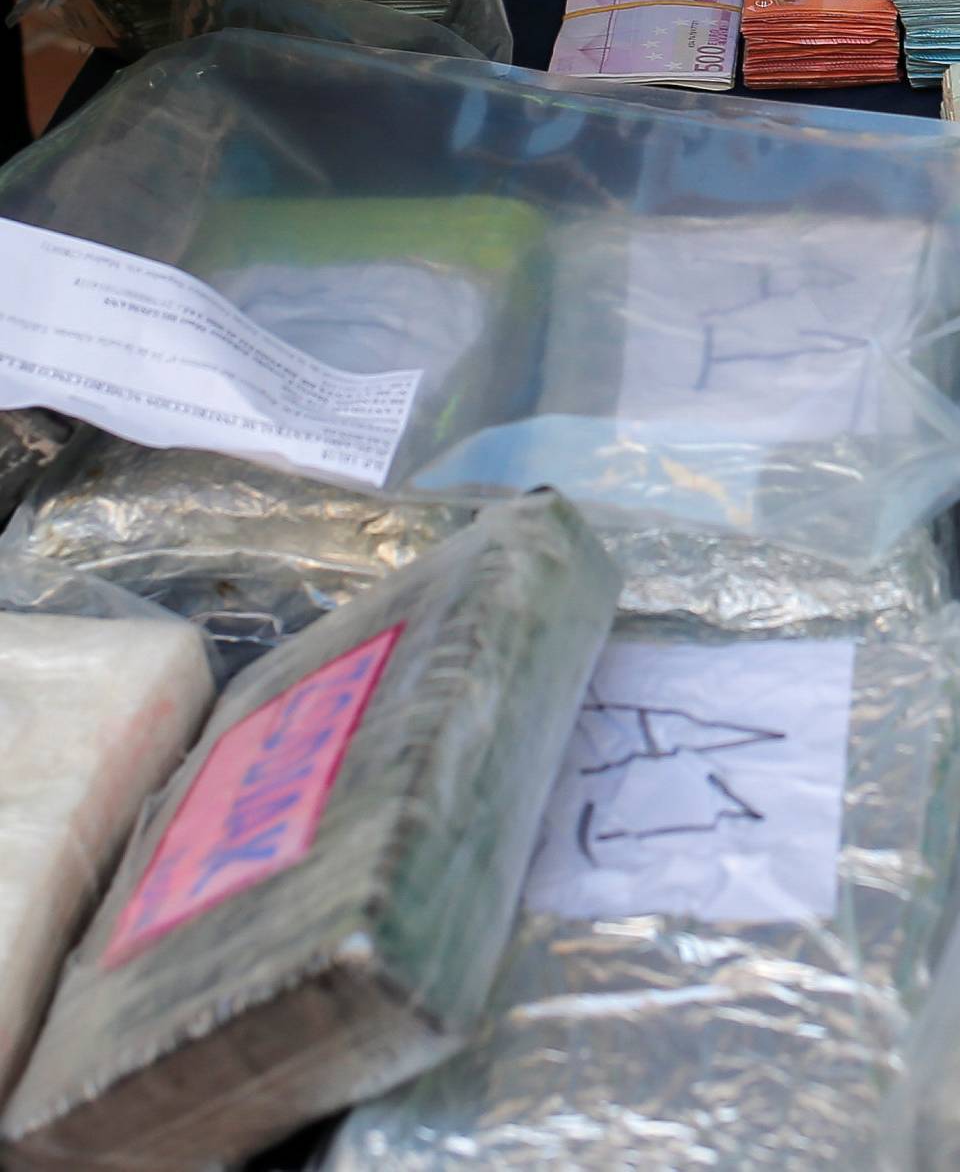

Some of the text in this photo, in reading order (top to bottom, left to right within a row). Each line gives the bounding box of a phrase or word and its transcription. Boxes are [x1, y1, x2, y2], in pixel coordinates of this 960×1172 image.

[694, 28, 724, 73] 500 EURO
[577, 700, 787, 869] A1
